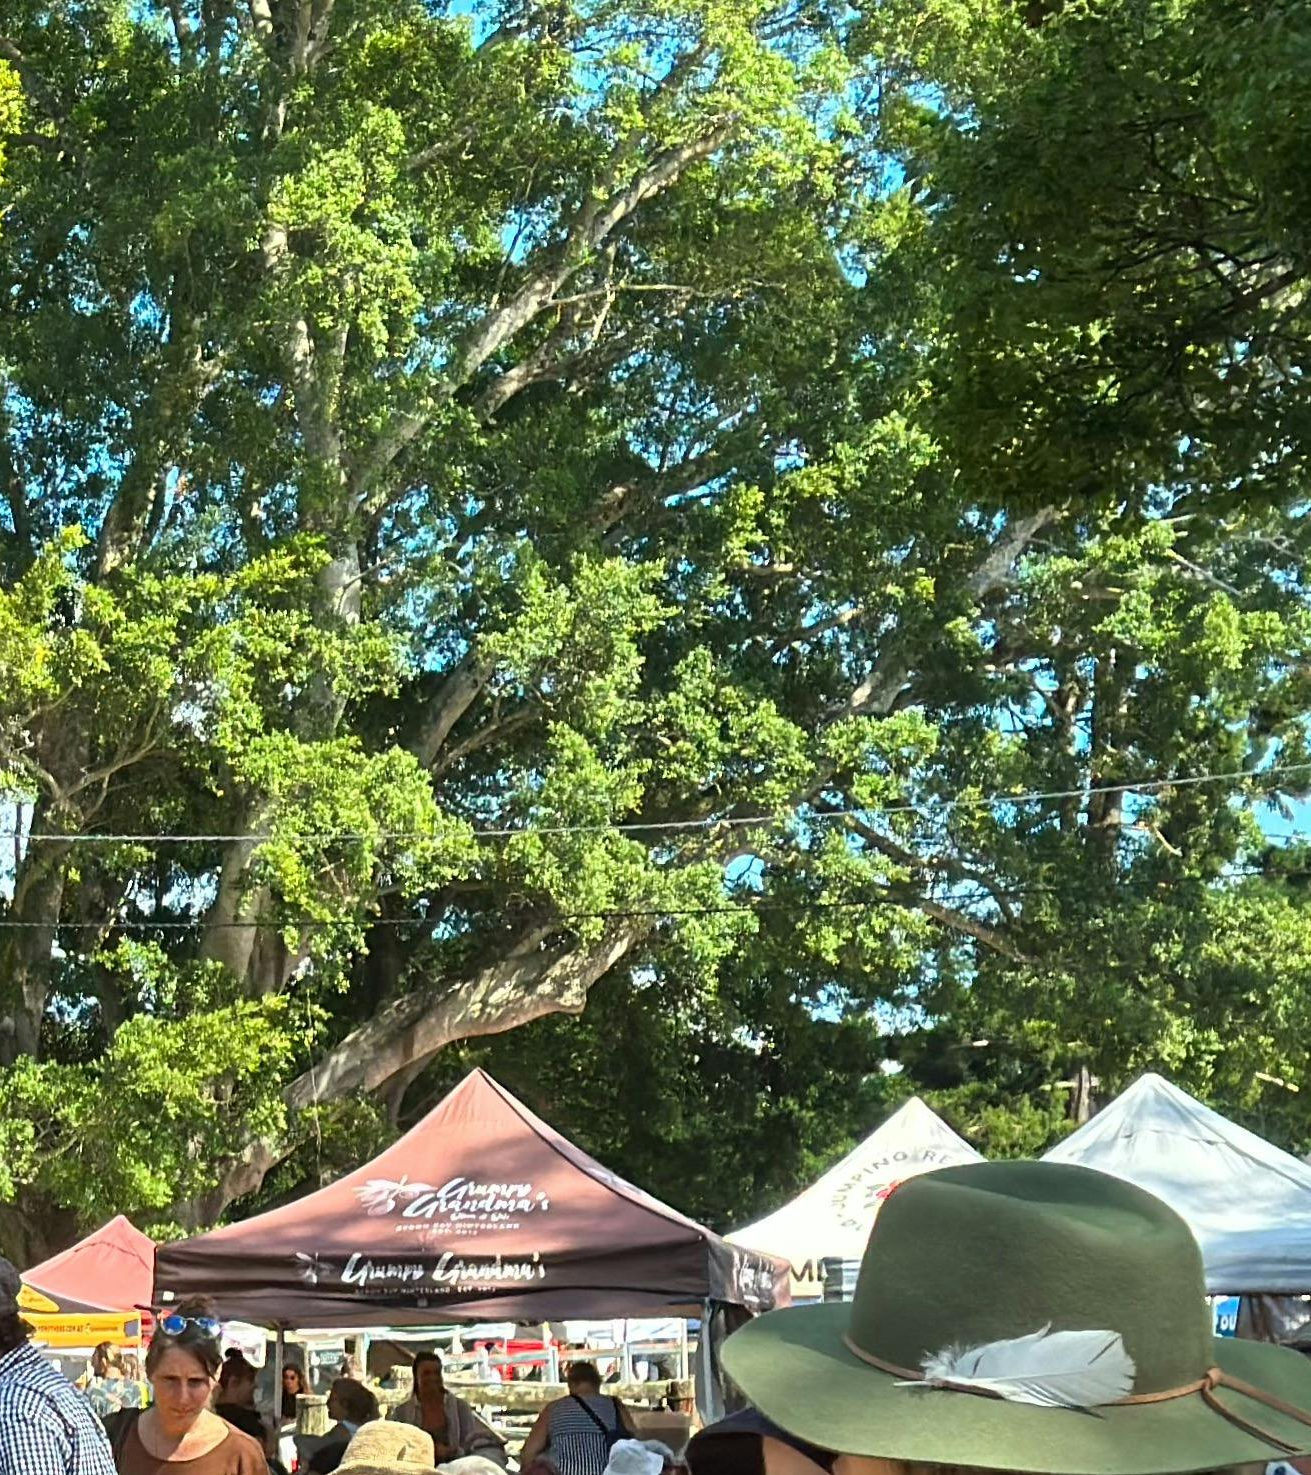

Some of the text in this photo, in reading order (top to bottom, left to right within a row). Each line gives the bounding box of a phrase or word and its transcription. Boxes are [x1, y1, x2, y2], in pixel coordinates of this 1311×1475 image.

[921, 1149, 954, 1165] RE
[341, 1251, 545, 1287] Grumpy Grandma's
